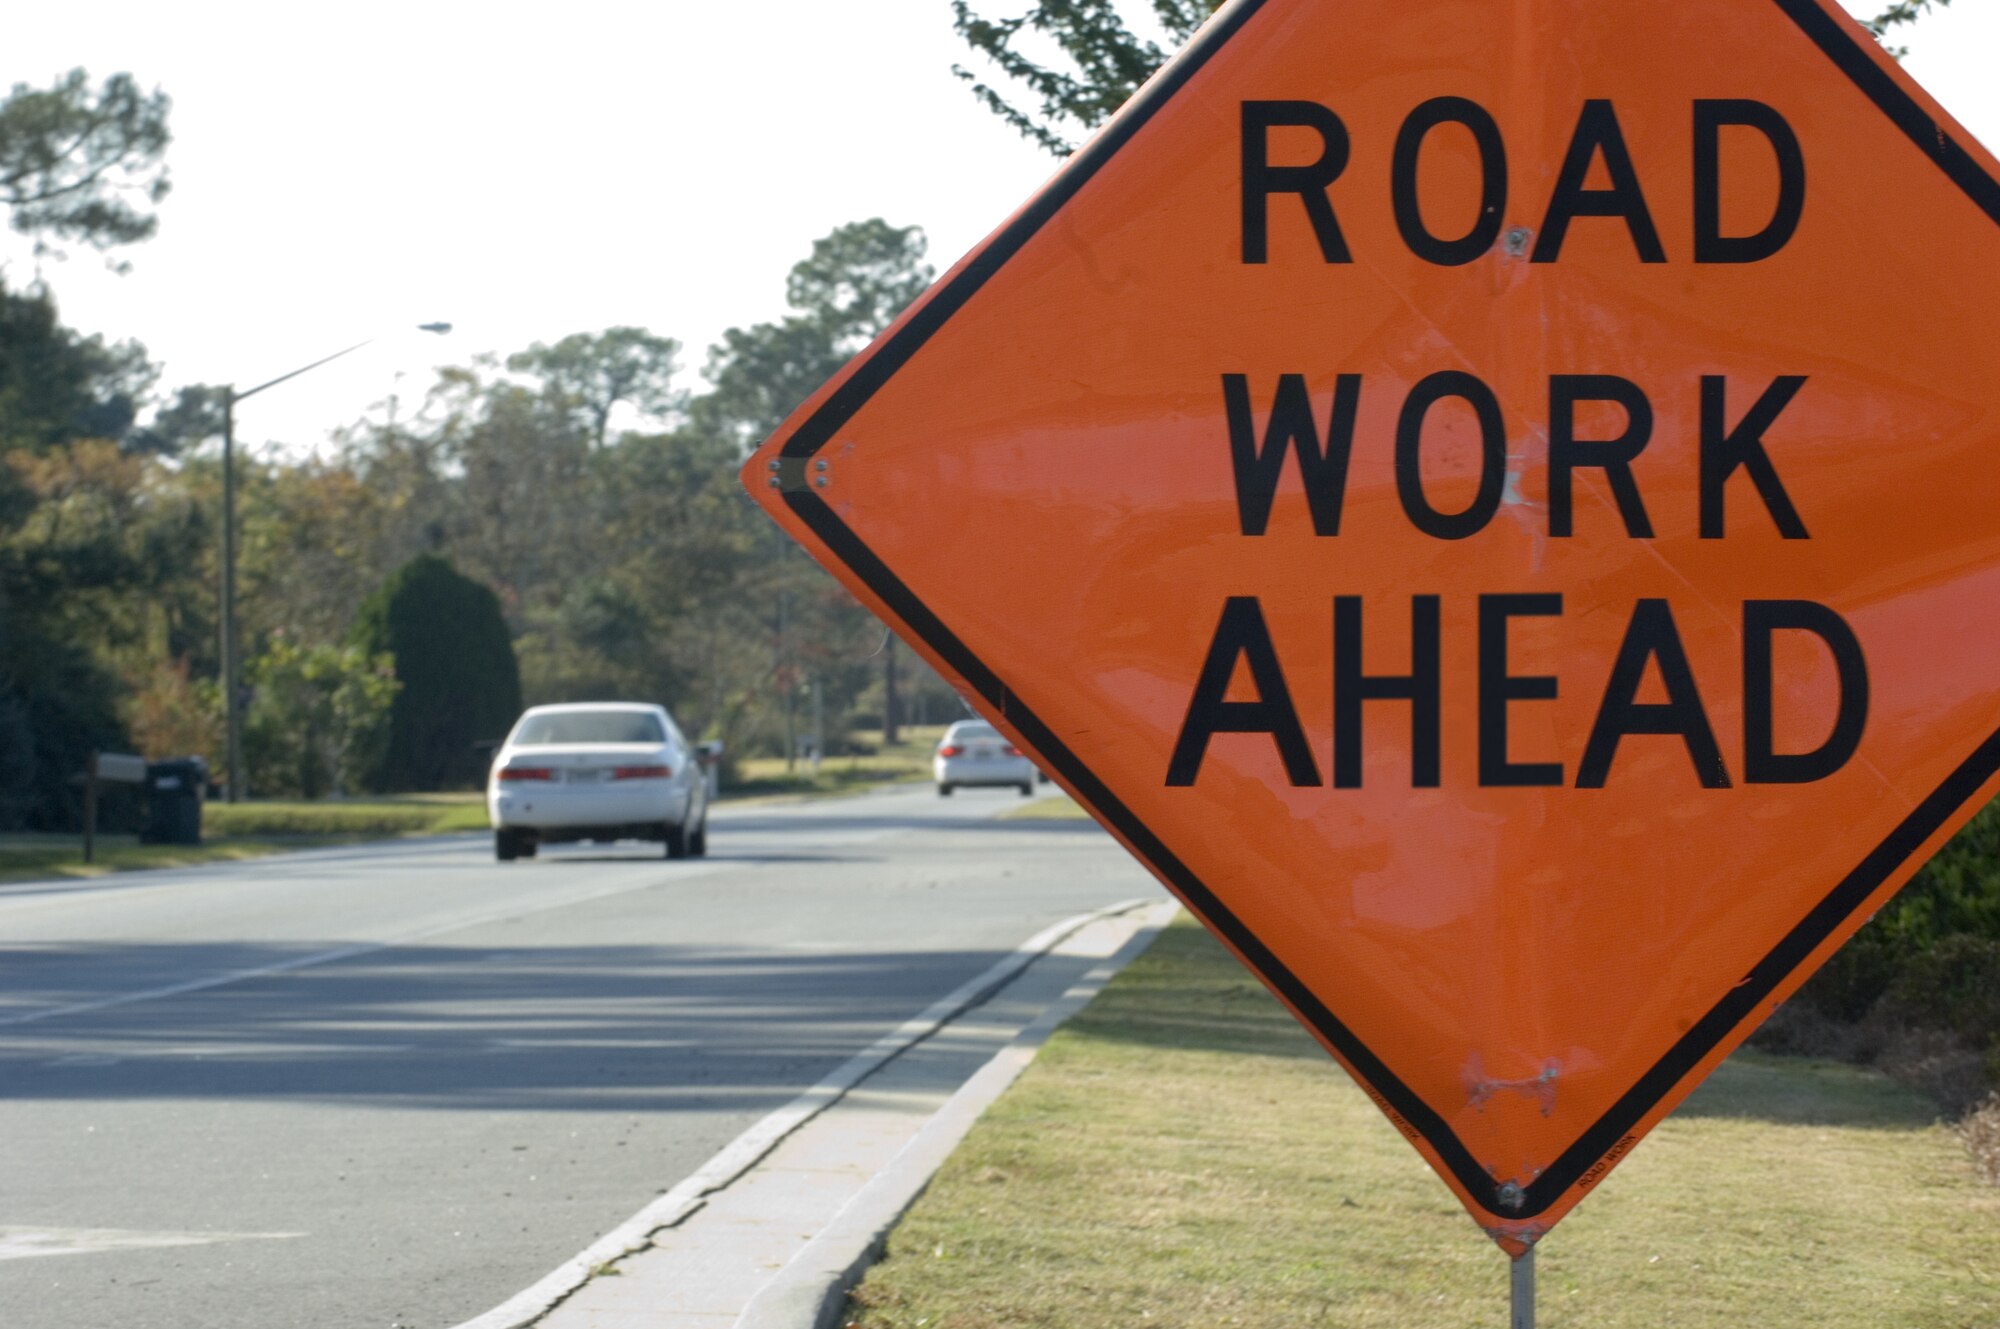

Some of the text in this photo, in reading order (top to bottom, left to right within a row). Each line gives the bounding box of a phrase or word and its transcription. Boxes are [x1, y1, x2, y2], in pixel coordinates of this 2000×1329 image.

[1240, 95, 1805, 266] ROAD
[1222, 370, 1810, 540] WORK
[1165, 593, 1871, 790] AHEAD
[1578, 1136, 1636, 1188] ROAD WORK
